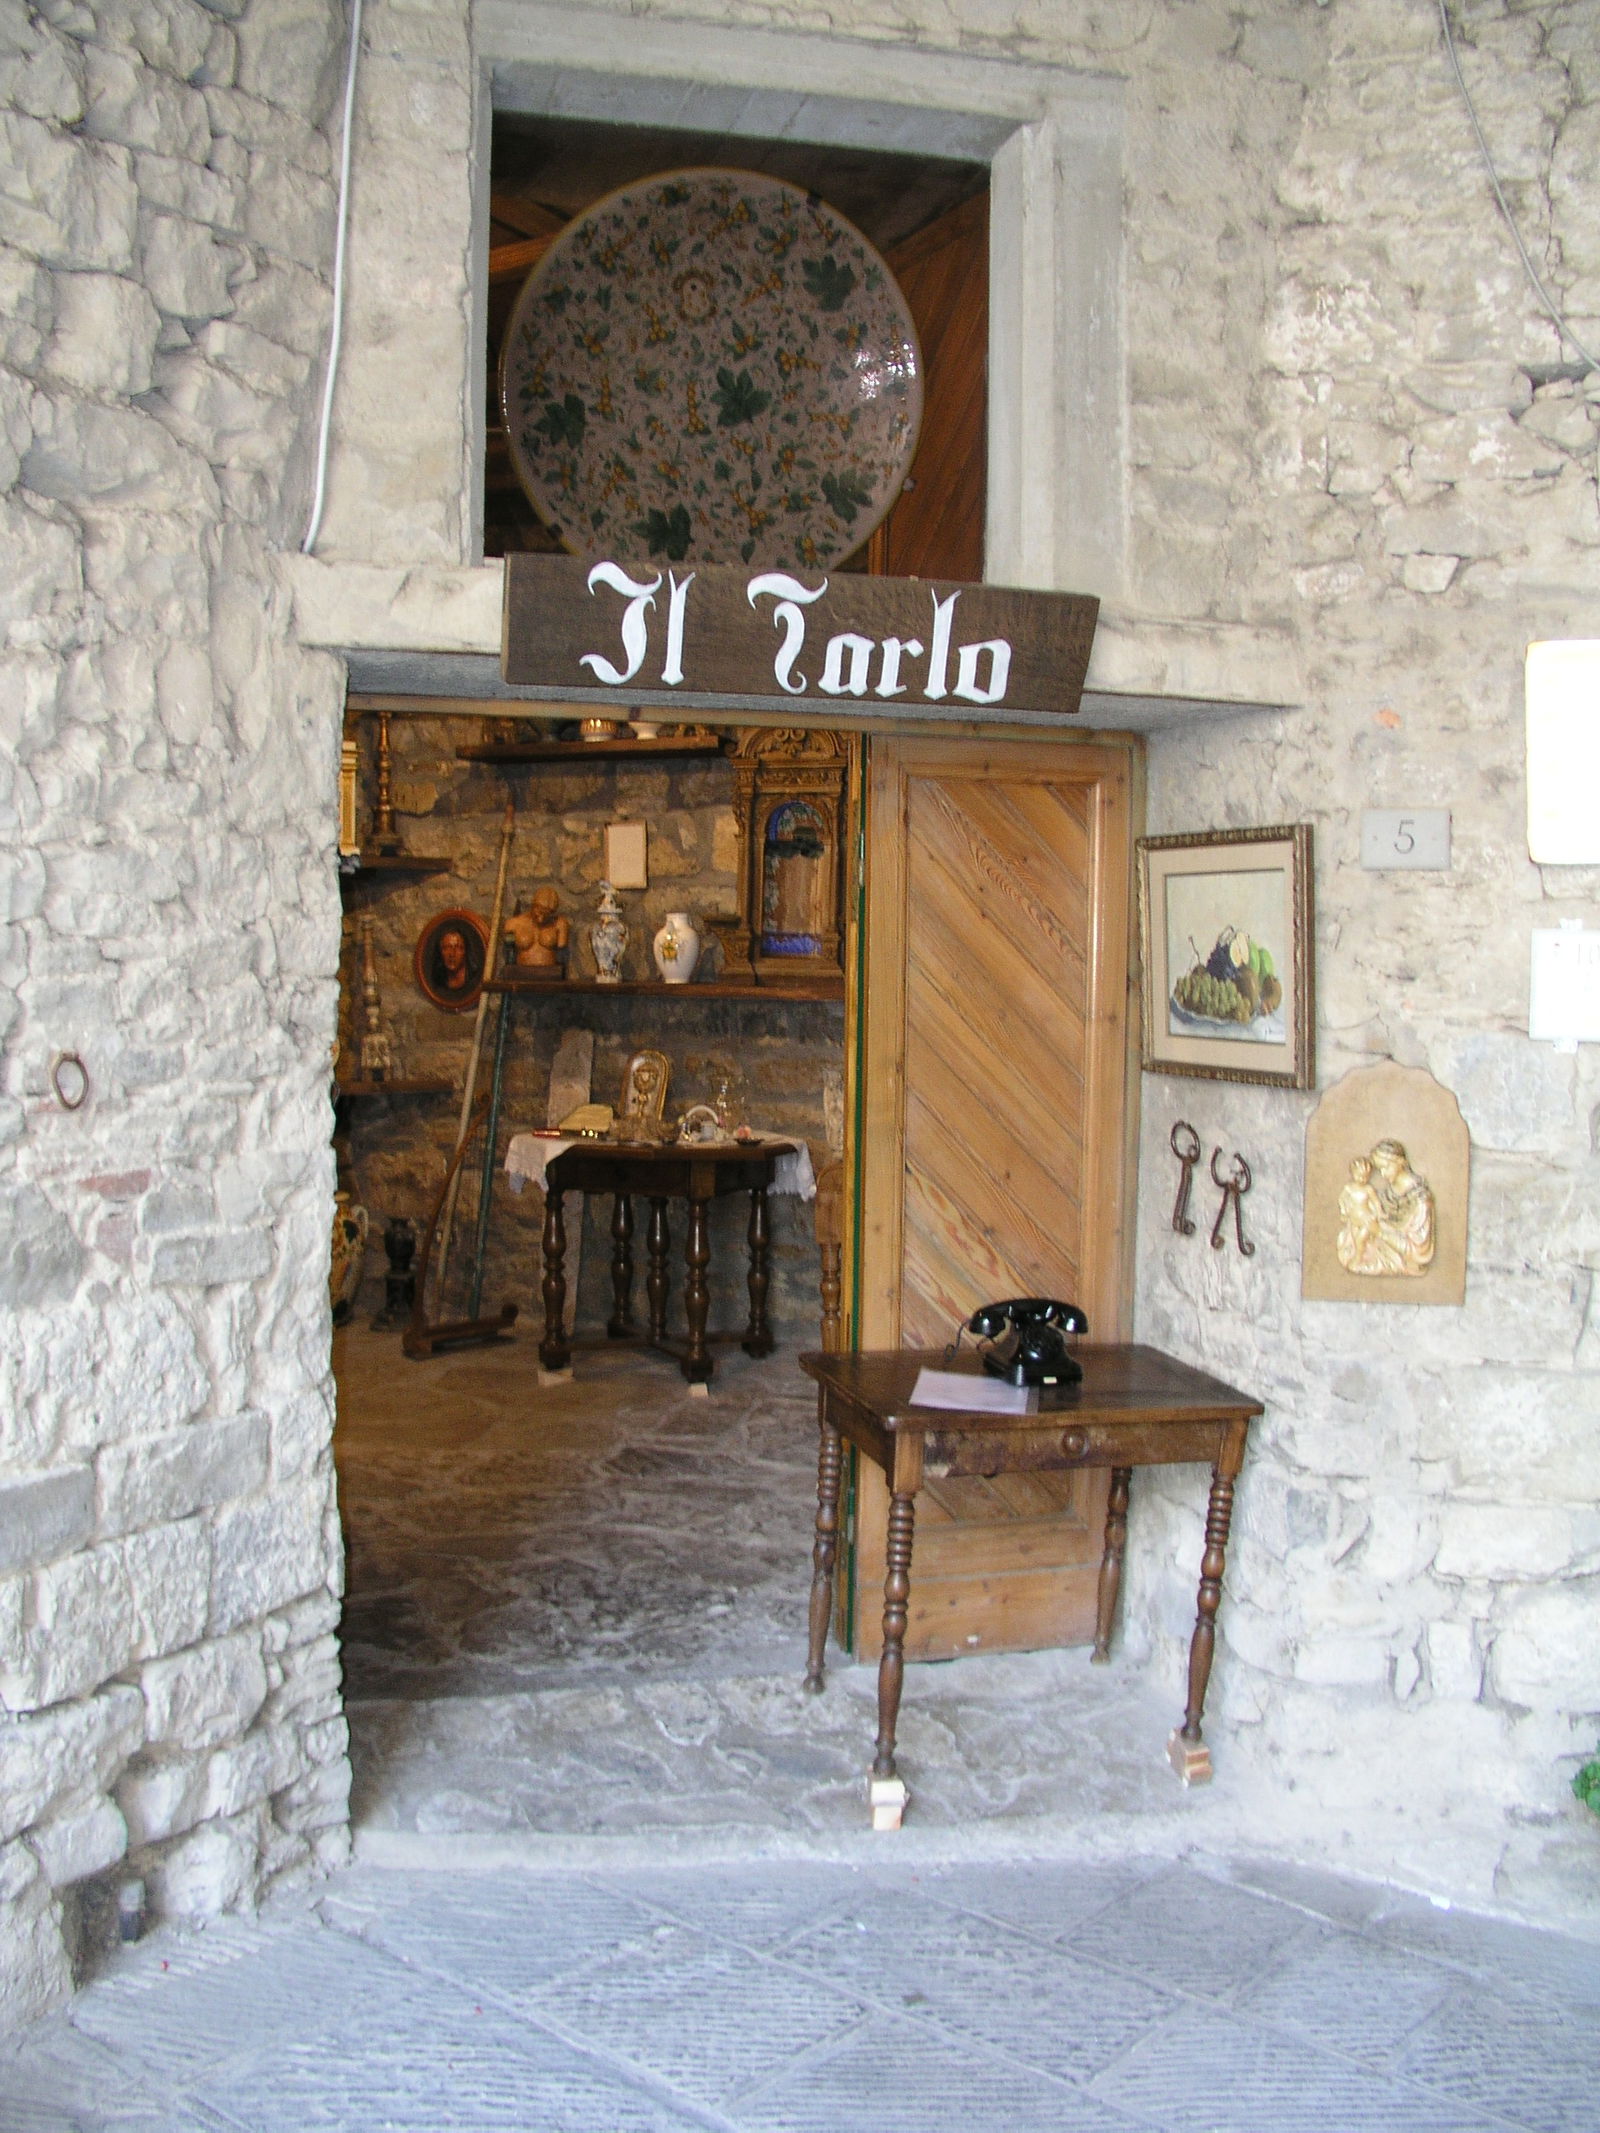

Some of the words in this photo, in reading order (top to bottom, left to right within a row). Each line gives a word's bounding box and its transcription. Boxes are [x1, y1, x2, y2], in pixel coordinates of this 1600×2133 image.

[579, 561, 696, 686] Il
[747, 573, 1012, 704] Tarlo
[1394, 819, 1415, 854] 5
